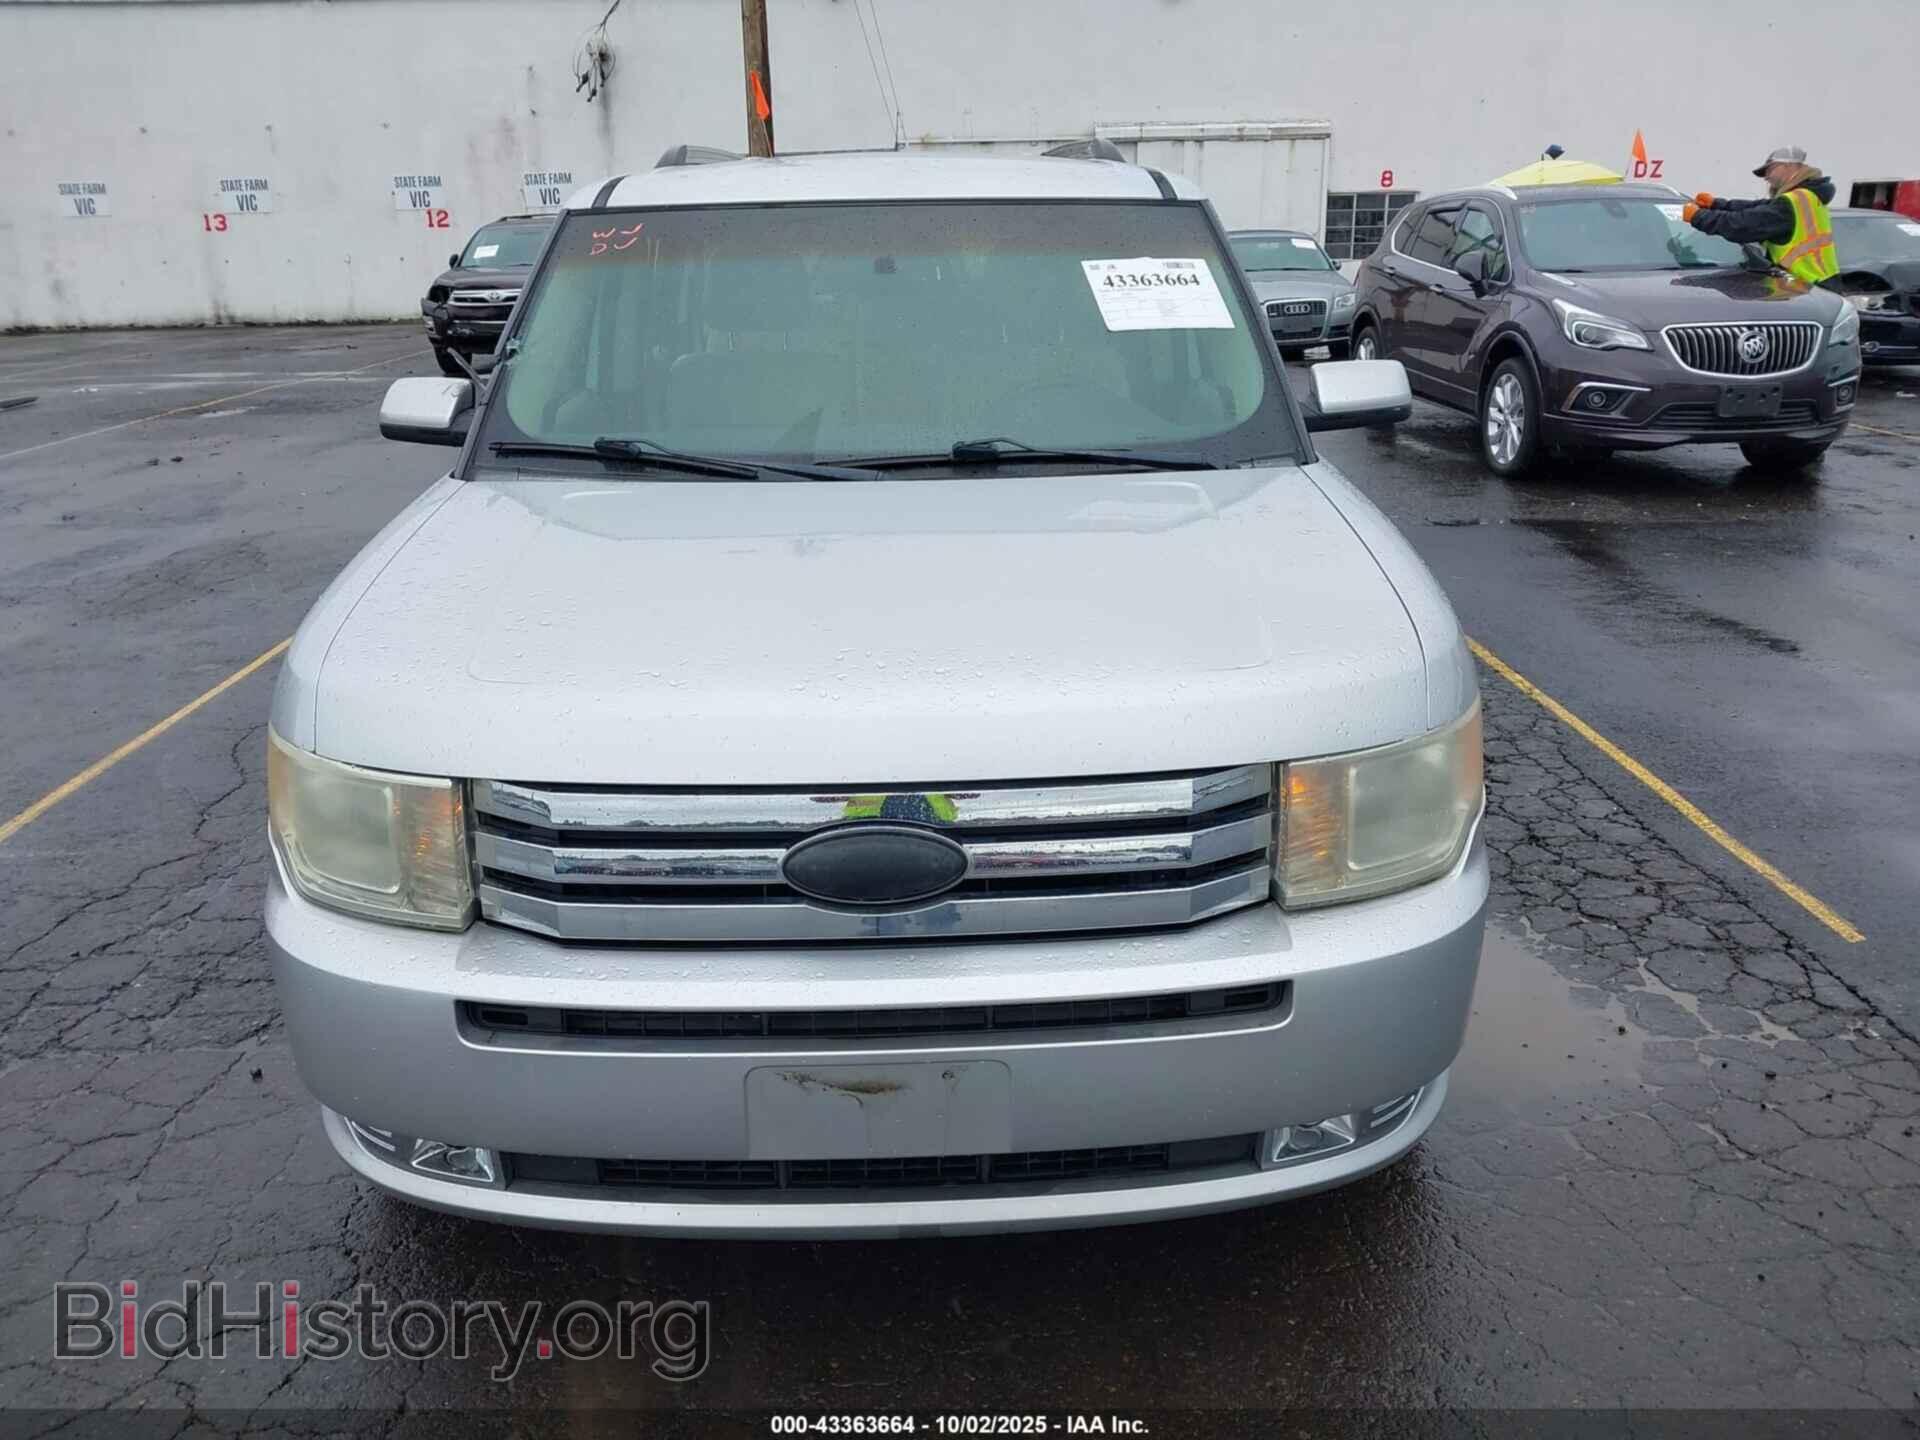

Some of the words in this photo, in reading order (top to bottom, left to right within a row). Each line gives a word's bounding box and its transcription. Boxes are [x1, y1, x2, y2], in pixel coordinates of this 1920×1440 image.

[220, 180, 242, 192] STATE
[244, 179, 268, 191] FARM
[394, 177, 416, 188] STATE
[418, 175, 442, 187] FARM
[524, 174, 547, 186] STATE
[549, 172, 572, 185] FARM
[1381, 170, 1393, 187] 8
[58, 183, 80, 195] STATE
[82, 182, 106, 194] FARM
[540, 188, 560, 205] VIC
[74, 198, 96, 215] VIC
[236, 194, 258, 211] VIC
[410, 191, 431, 208] VIC
[203, 214, 227, 231] 13
[427, 211, 450, 228] 12
[1103, 273, 1200, 288] 43363664
